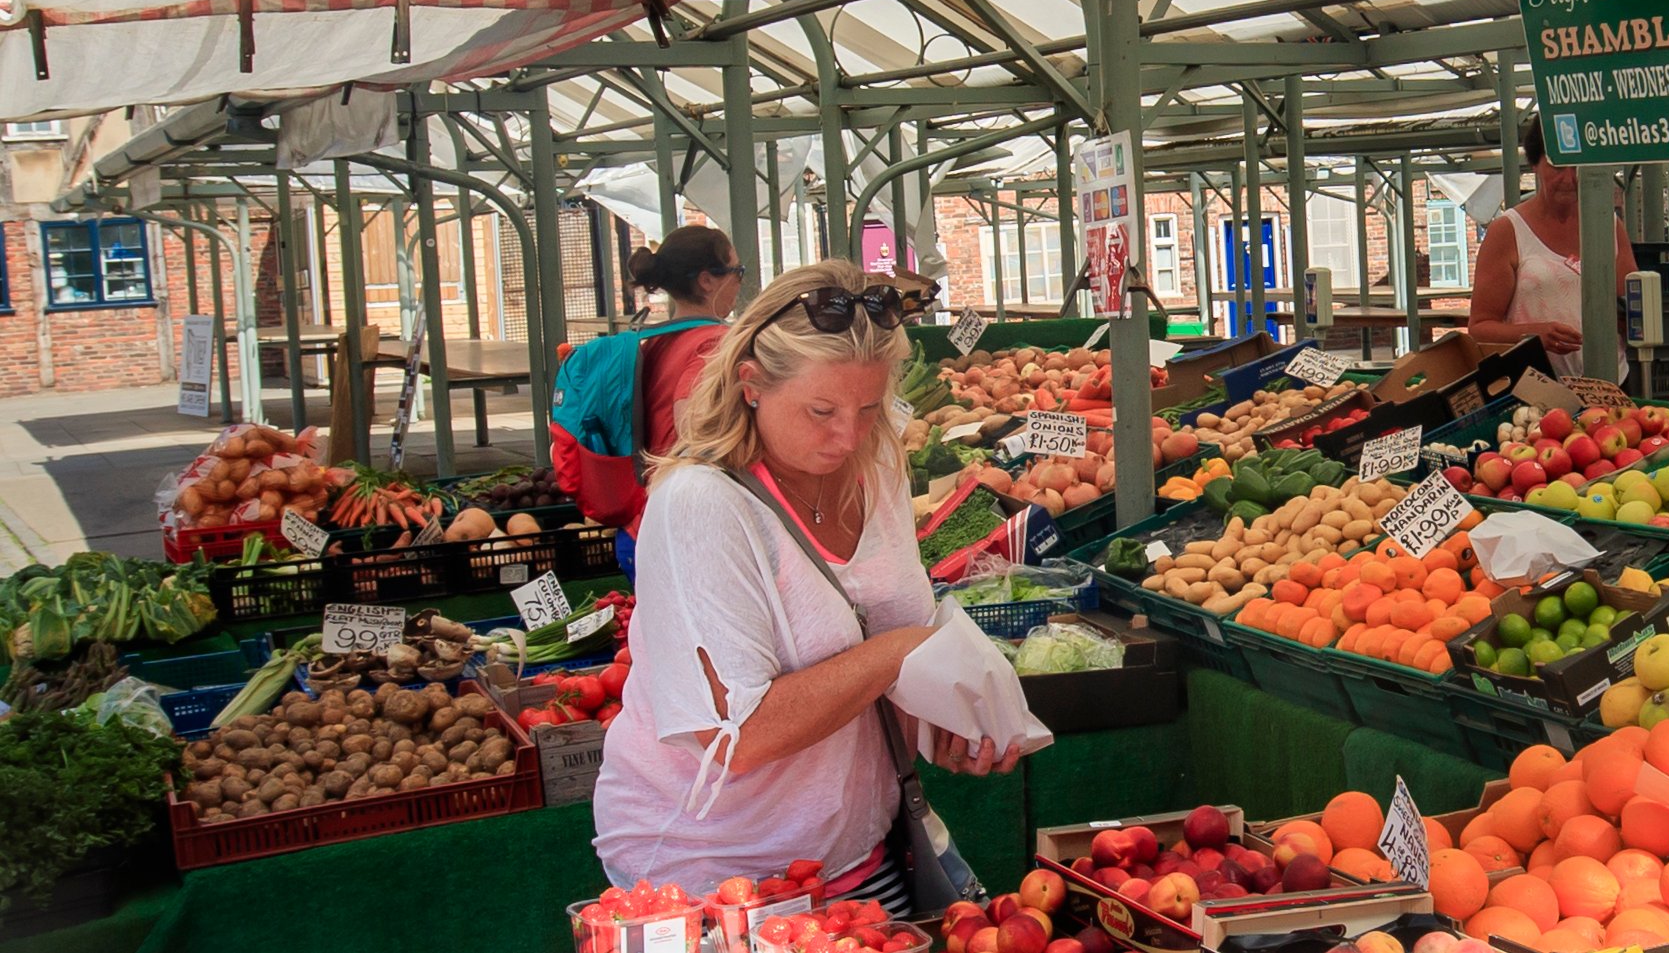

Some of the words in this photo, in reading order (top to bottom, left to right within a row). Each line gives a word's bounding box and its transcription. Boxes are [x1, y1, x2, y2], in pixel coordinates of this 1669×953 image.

[1545, 70, 1606, 105] MONDAY
[1030, 411, 1079, 423] SPANISH
[1031, 421, 1084, 436] ONIONS
[1388, 480, 1451, 537] MANDARIN
[326, 603, 390, 616] ENGLISH
[524, 590, 548, 622] 75
[537, 578, 561, 622] CUCUMBE
[334, 628, 378, 650] 99
